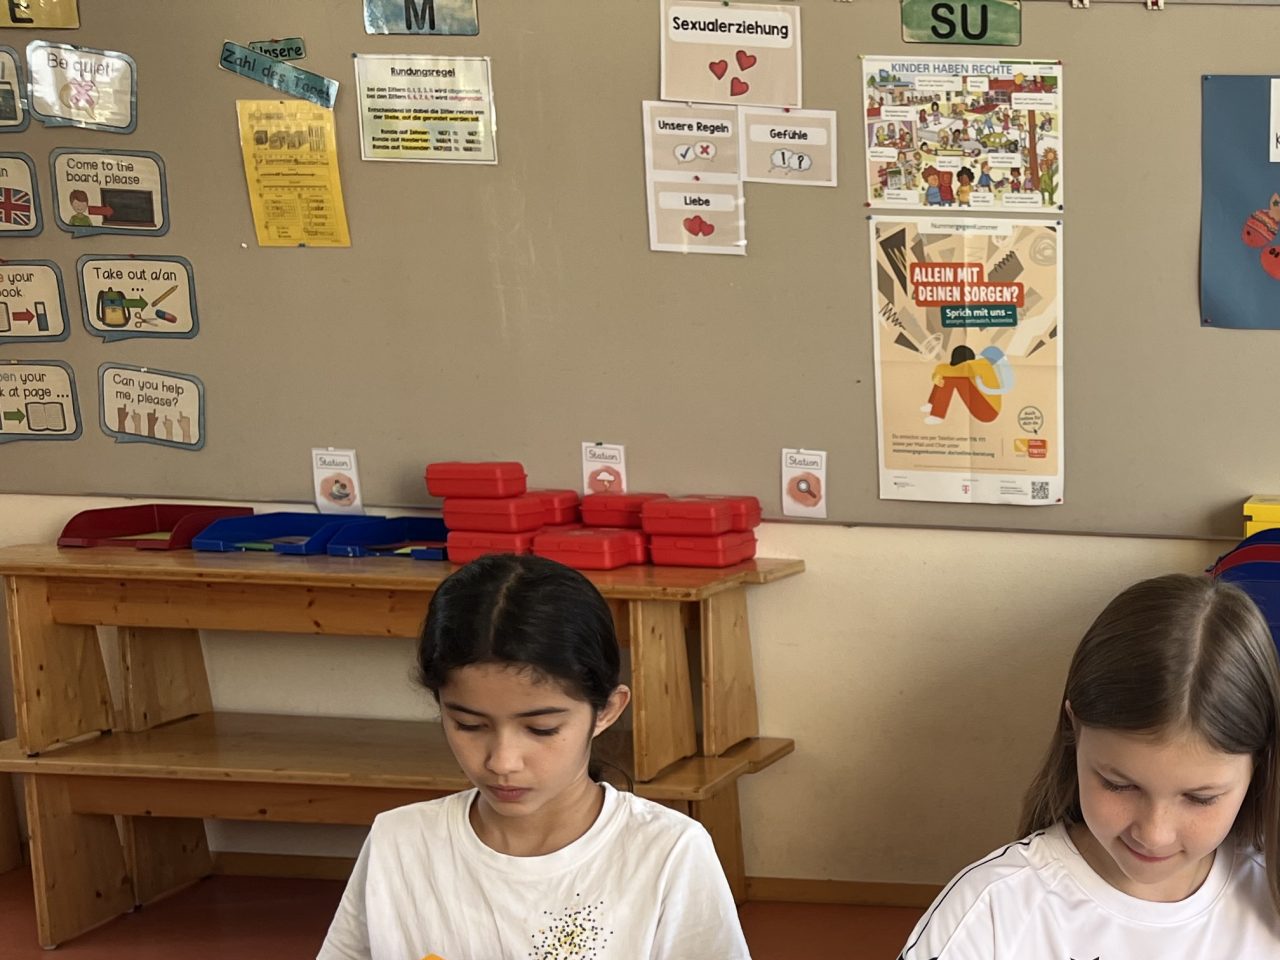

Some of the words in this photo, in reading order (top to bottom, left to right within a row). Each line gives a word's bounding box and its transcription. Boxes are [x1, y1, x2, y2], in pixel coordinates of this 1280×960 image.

[404, 0, 436, 31] M
[931, 3, 988, 40] SU
[672, 16, 789, 39] Sexualerziehung
[47, 53, 68, 70] Be
[222, 48, 256, 72] Zahl
[261, 64, 287, 83] des
[390, 67, 456, 78] Rundungsregel
[891, 63, 930, 73] KINDER
[933, 63, 969, 74] HABEN
[972, 64, 1012, 75] RECHTE
[658, 120, 693, 132] Unsere
[696, 121, 729, 134] Regeln
[769, 128, 808, 140] Gefühle
[66, 158, 98, 171] Come
[101, 159, 114, 172] to
[116, 160, 134, 172] the
[66, 171, 102, 185] board,
[684, 196, 711, 207] Liebe
[8, 273, 34, 285] your
[93, 267, 124, 280] Take
[127, 268, 147, 281] out
[150, 268, 177, 282] a/an
[913, 267, 955, 283] ALLEIN
[957, 267, 980, 283] MIT
[918, 286, 961, 302] DEINEN
[963, 286, 1019, 303] SORGEN?
[946, 307, 972, 319] Sprich
[973, 308, 989, 317] mit
[990, 309, 1006, 317] uns
[20, 373, 47, 385] your
[113, 373, 135, 387] Can
[138, 378, 159, 391] you
[161, 381, 184, 396] help
[9, 386, 20, 398] at
[24, 388, 51, 400] page
[115, 390, 135, 403] me,
[137, 392, 178, 407] please?
[319, 456, 349, 468] Station
[589, 449, 618, 461] Station
[789, 455, 819, 467] Station
